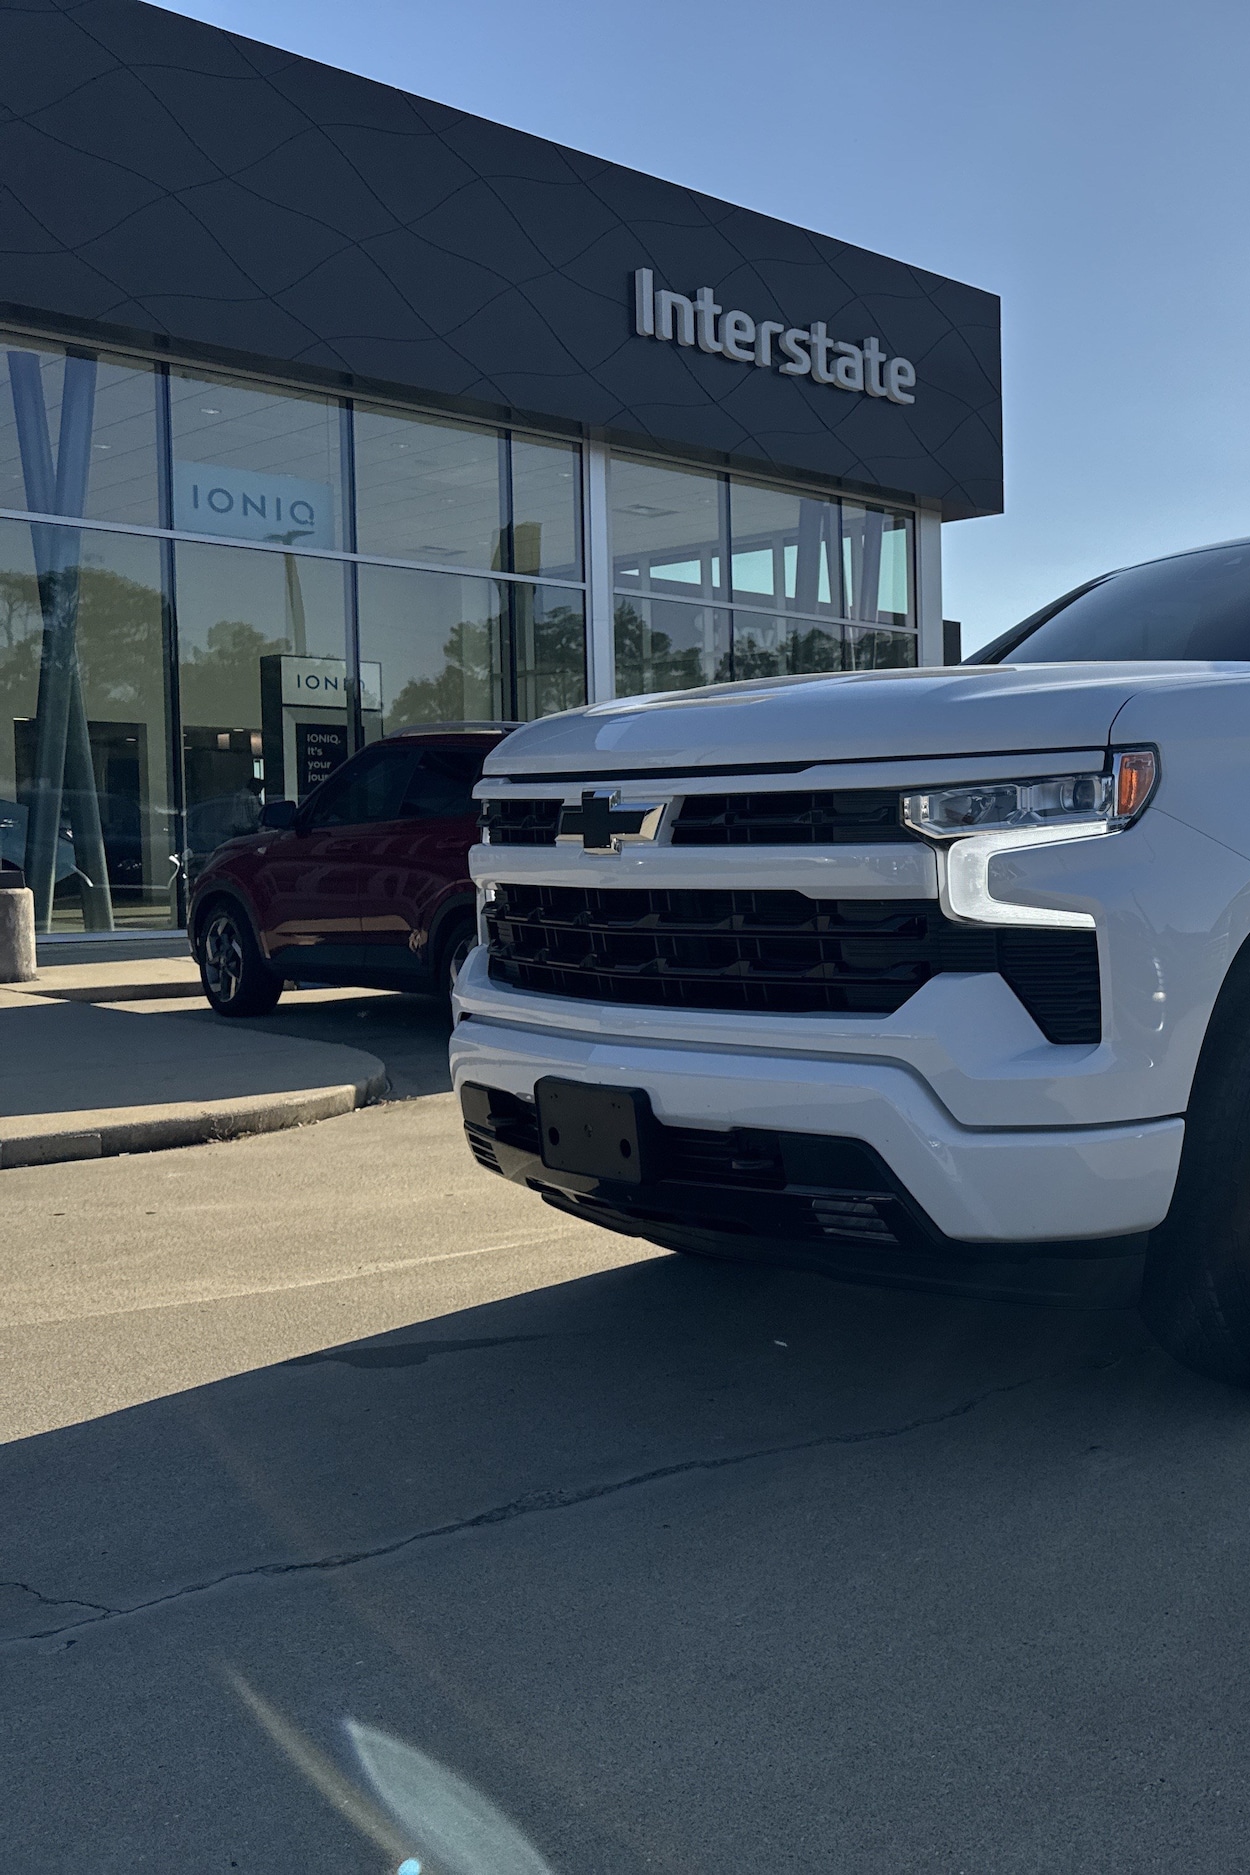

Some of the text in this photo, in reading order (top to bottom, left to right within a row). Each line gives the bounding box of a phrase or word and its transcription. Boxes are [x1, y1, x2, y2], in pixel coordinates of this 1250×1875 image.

[634, 267, 916, 405] Interstate
[193, 484, 315, 526] IONIQ
[297, 674, 365, 692] IONI
[307, 746, 323, 756] It's
[307, 761, 331, 770] your
